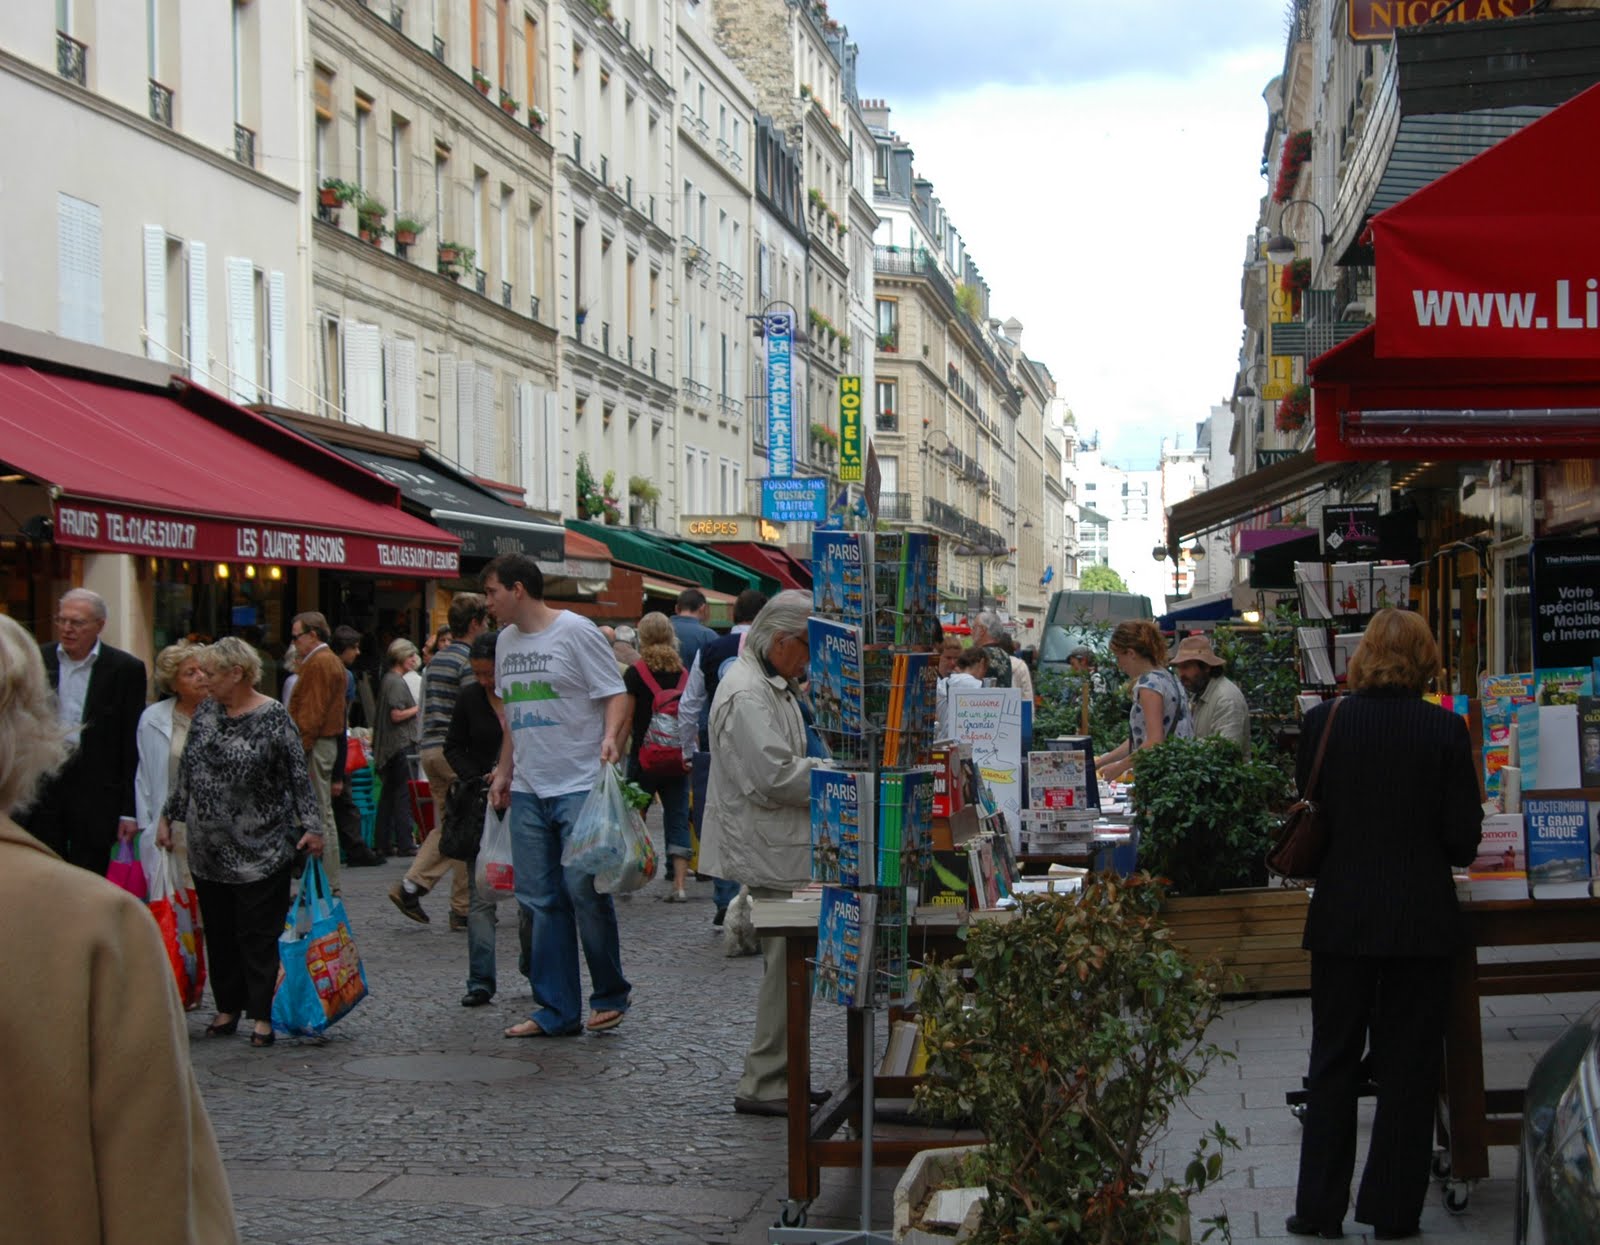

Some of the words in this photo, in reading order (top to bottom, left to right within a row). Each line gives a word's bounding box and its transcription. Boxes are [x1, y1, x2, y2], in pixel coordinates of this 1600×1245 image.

[1370, 0, 1513, 28] NICOLAS
[1271, 264, 1292, 380] HOTL
[769, 340, 790, 353] LA
[841, 378, 860, 456] HOTEL
[763, 479, 804, 490] POISSONS
[807, 479, 825, 490] FINS
[775, 500, 815, 511] TRAITEUR
[59, 507, 99, 538] FRUITS
[688, 519, 738, 536] CRÊPES
[237, 528, 258, 557] LES
[262, 530, 301, 561] QUATRE
[304, 535, 345, 564] SAISONS
[828, 543, 860, 561] PARIS
[1558, 586, 1594, 599] Votre
[1539, 600, 1600, 616] spécialis
[1553, 613, 1600, 628] Mobile
[1542, 630, 1556, 642] et
[825, 633, 857, 658] PARIS
[963, 719, 995, 734] Grands
[960, 731, 992, 743] enfants
[826, 782, 857, 801] PARIS
[1529, 800, 1586, 813] CLOSTERMANN
[1532, 815, 1544, 827] LE
[1547, 815, 1584, 827] GRAND
[1482, 831, 1518, 839] omorra
[1538, 827, 1578, 840] CIRQUE
[834, 900, 860, 922] PARIS
